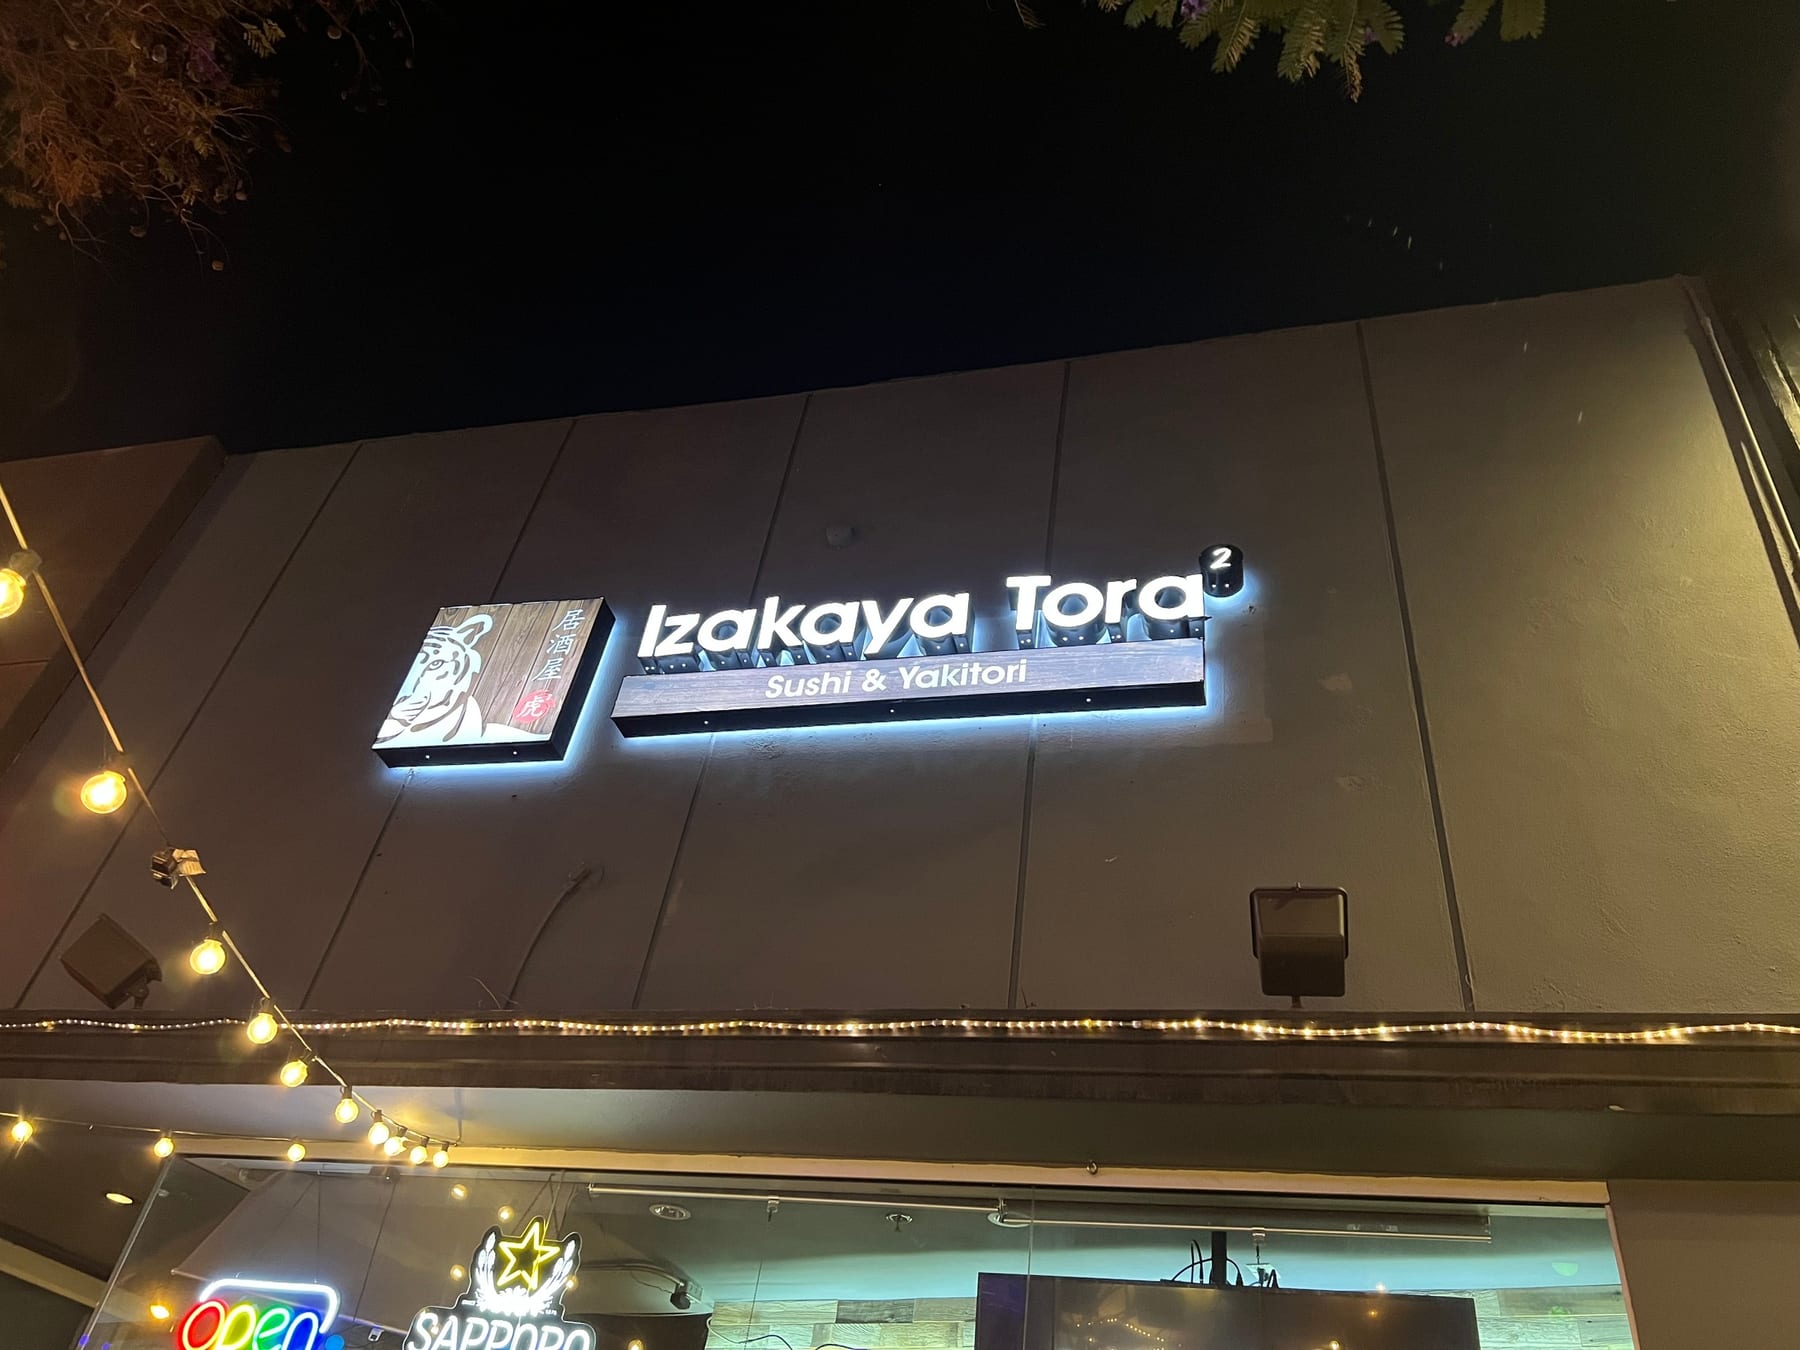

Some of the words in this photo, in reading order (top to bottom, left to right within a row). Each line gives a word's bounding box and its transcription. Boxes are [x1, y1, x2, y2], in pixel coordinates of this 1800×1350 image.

[638, 593, 970, 658] Izakaya
[1006, 573, 1204, 631] Tora
[1210, 547, 1233, 570] 2
[532, 608, 586, 682] 居酒屋
[765, 672, 852, 699] Sushi
[861, 668, 887, 692] &
[898, 658, 1028, 690] Yakitori
[516, 693, 553, 718] 虎
[407, 1311, 591, 1350] SAPPORO
